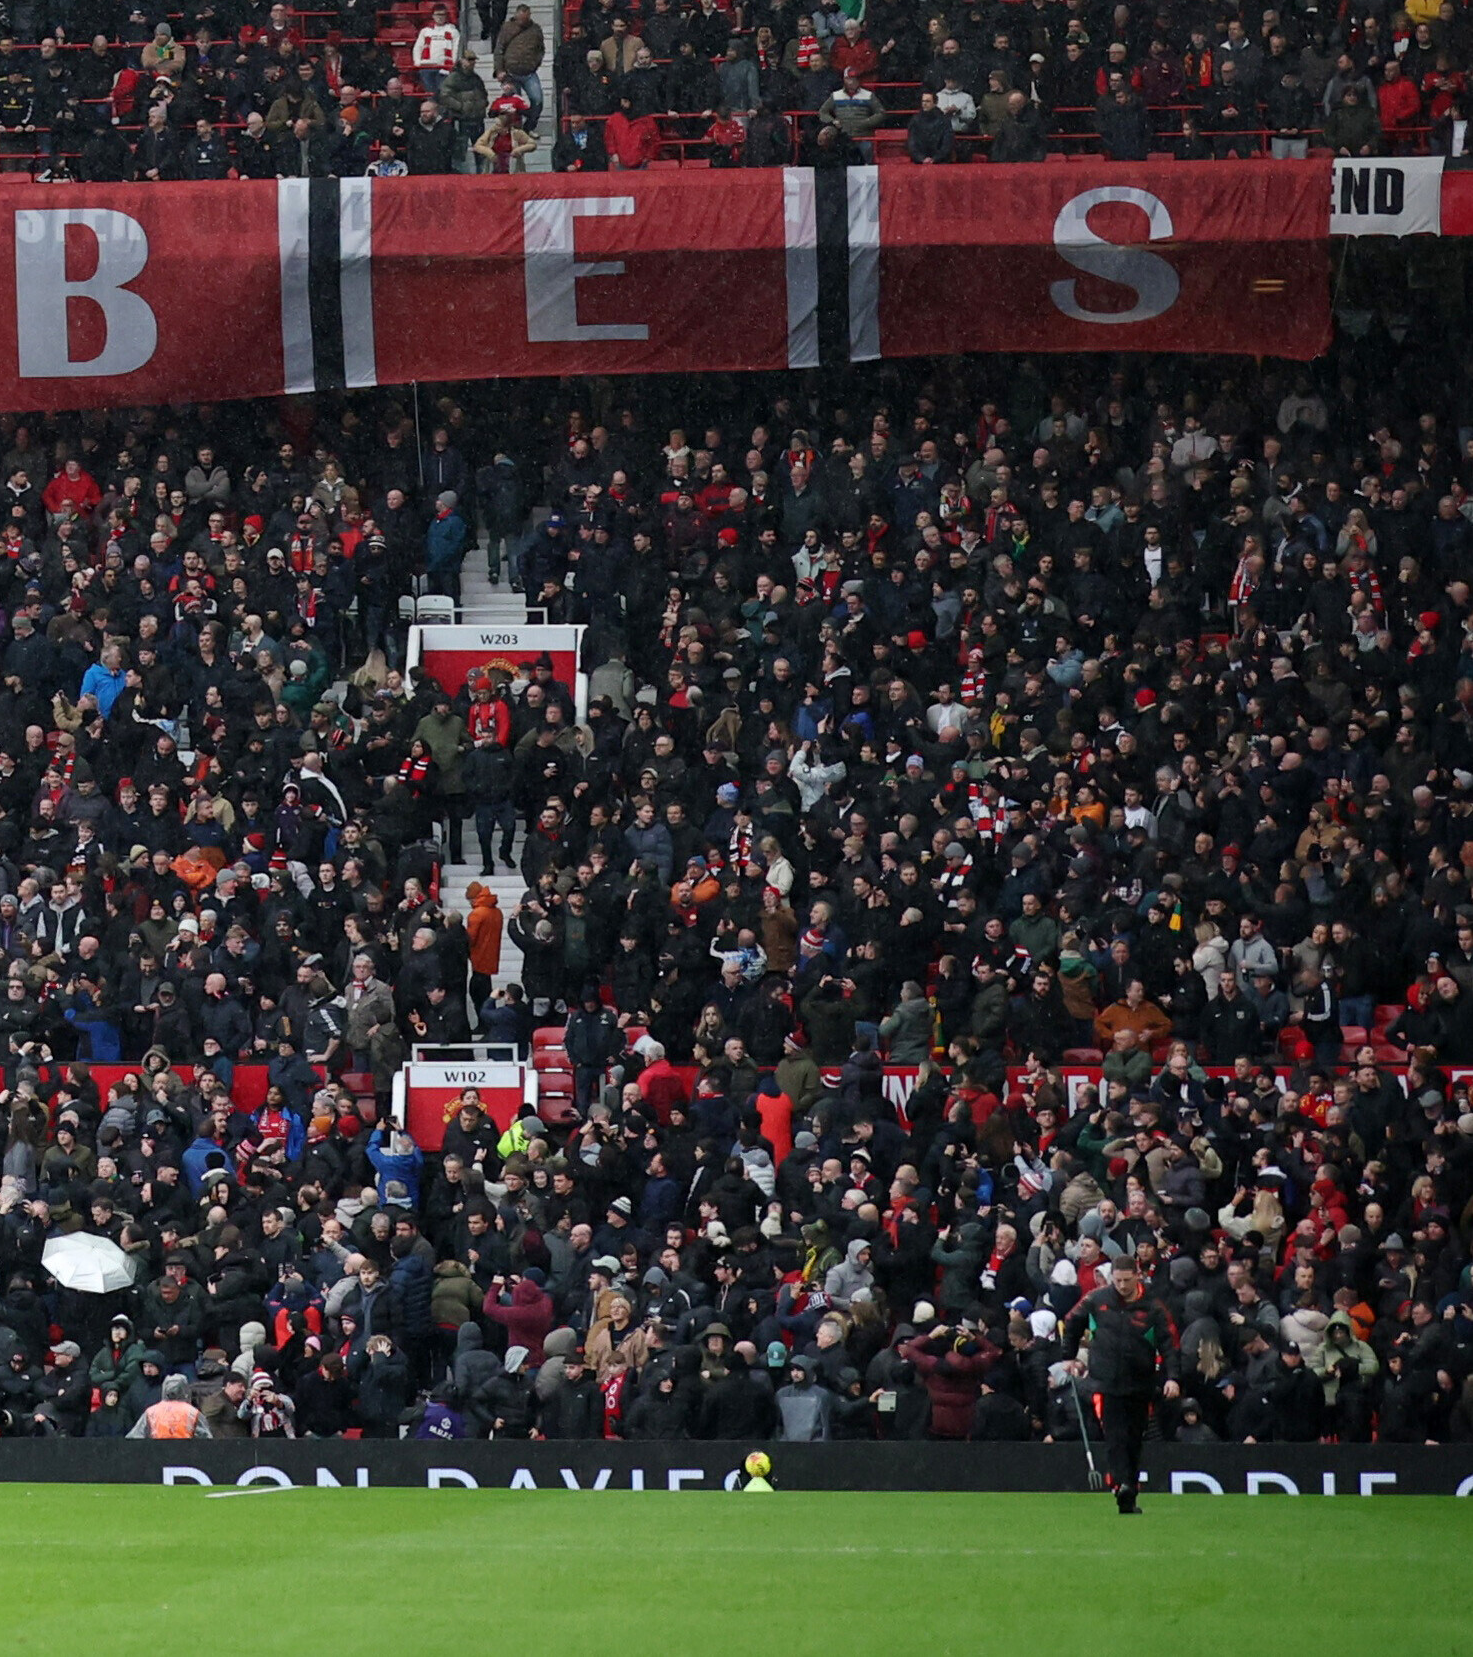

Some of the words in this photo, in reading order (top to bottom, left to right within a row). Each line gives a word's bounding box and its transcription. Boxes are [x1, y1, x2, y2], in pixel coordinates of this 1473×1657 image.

[1330, 166, 1405, 217] ND
[479, 633, 519, 646] W203
[444, 1070, 486, 1084] W102
